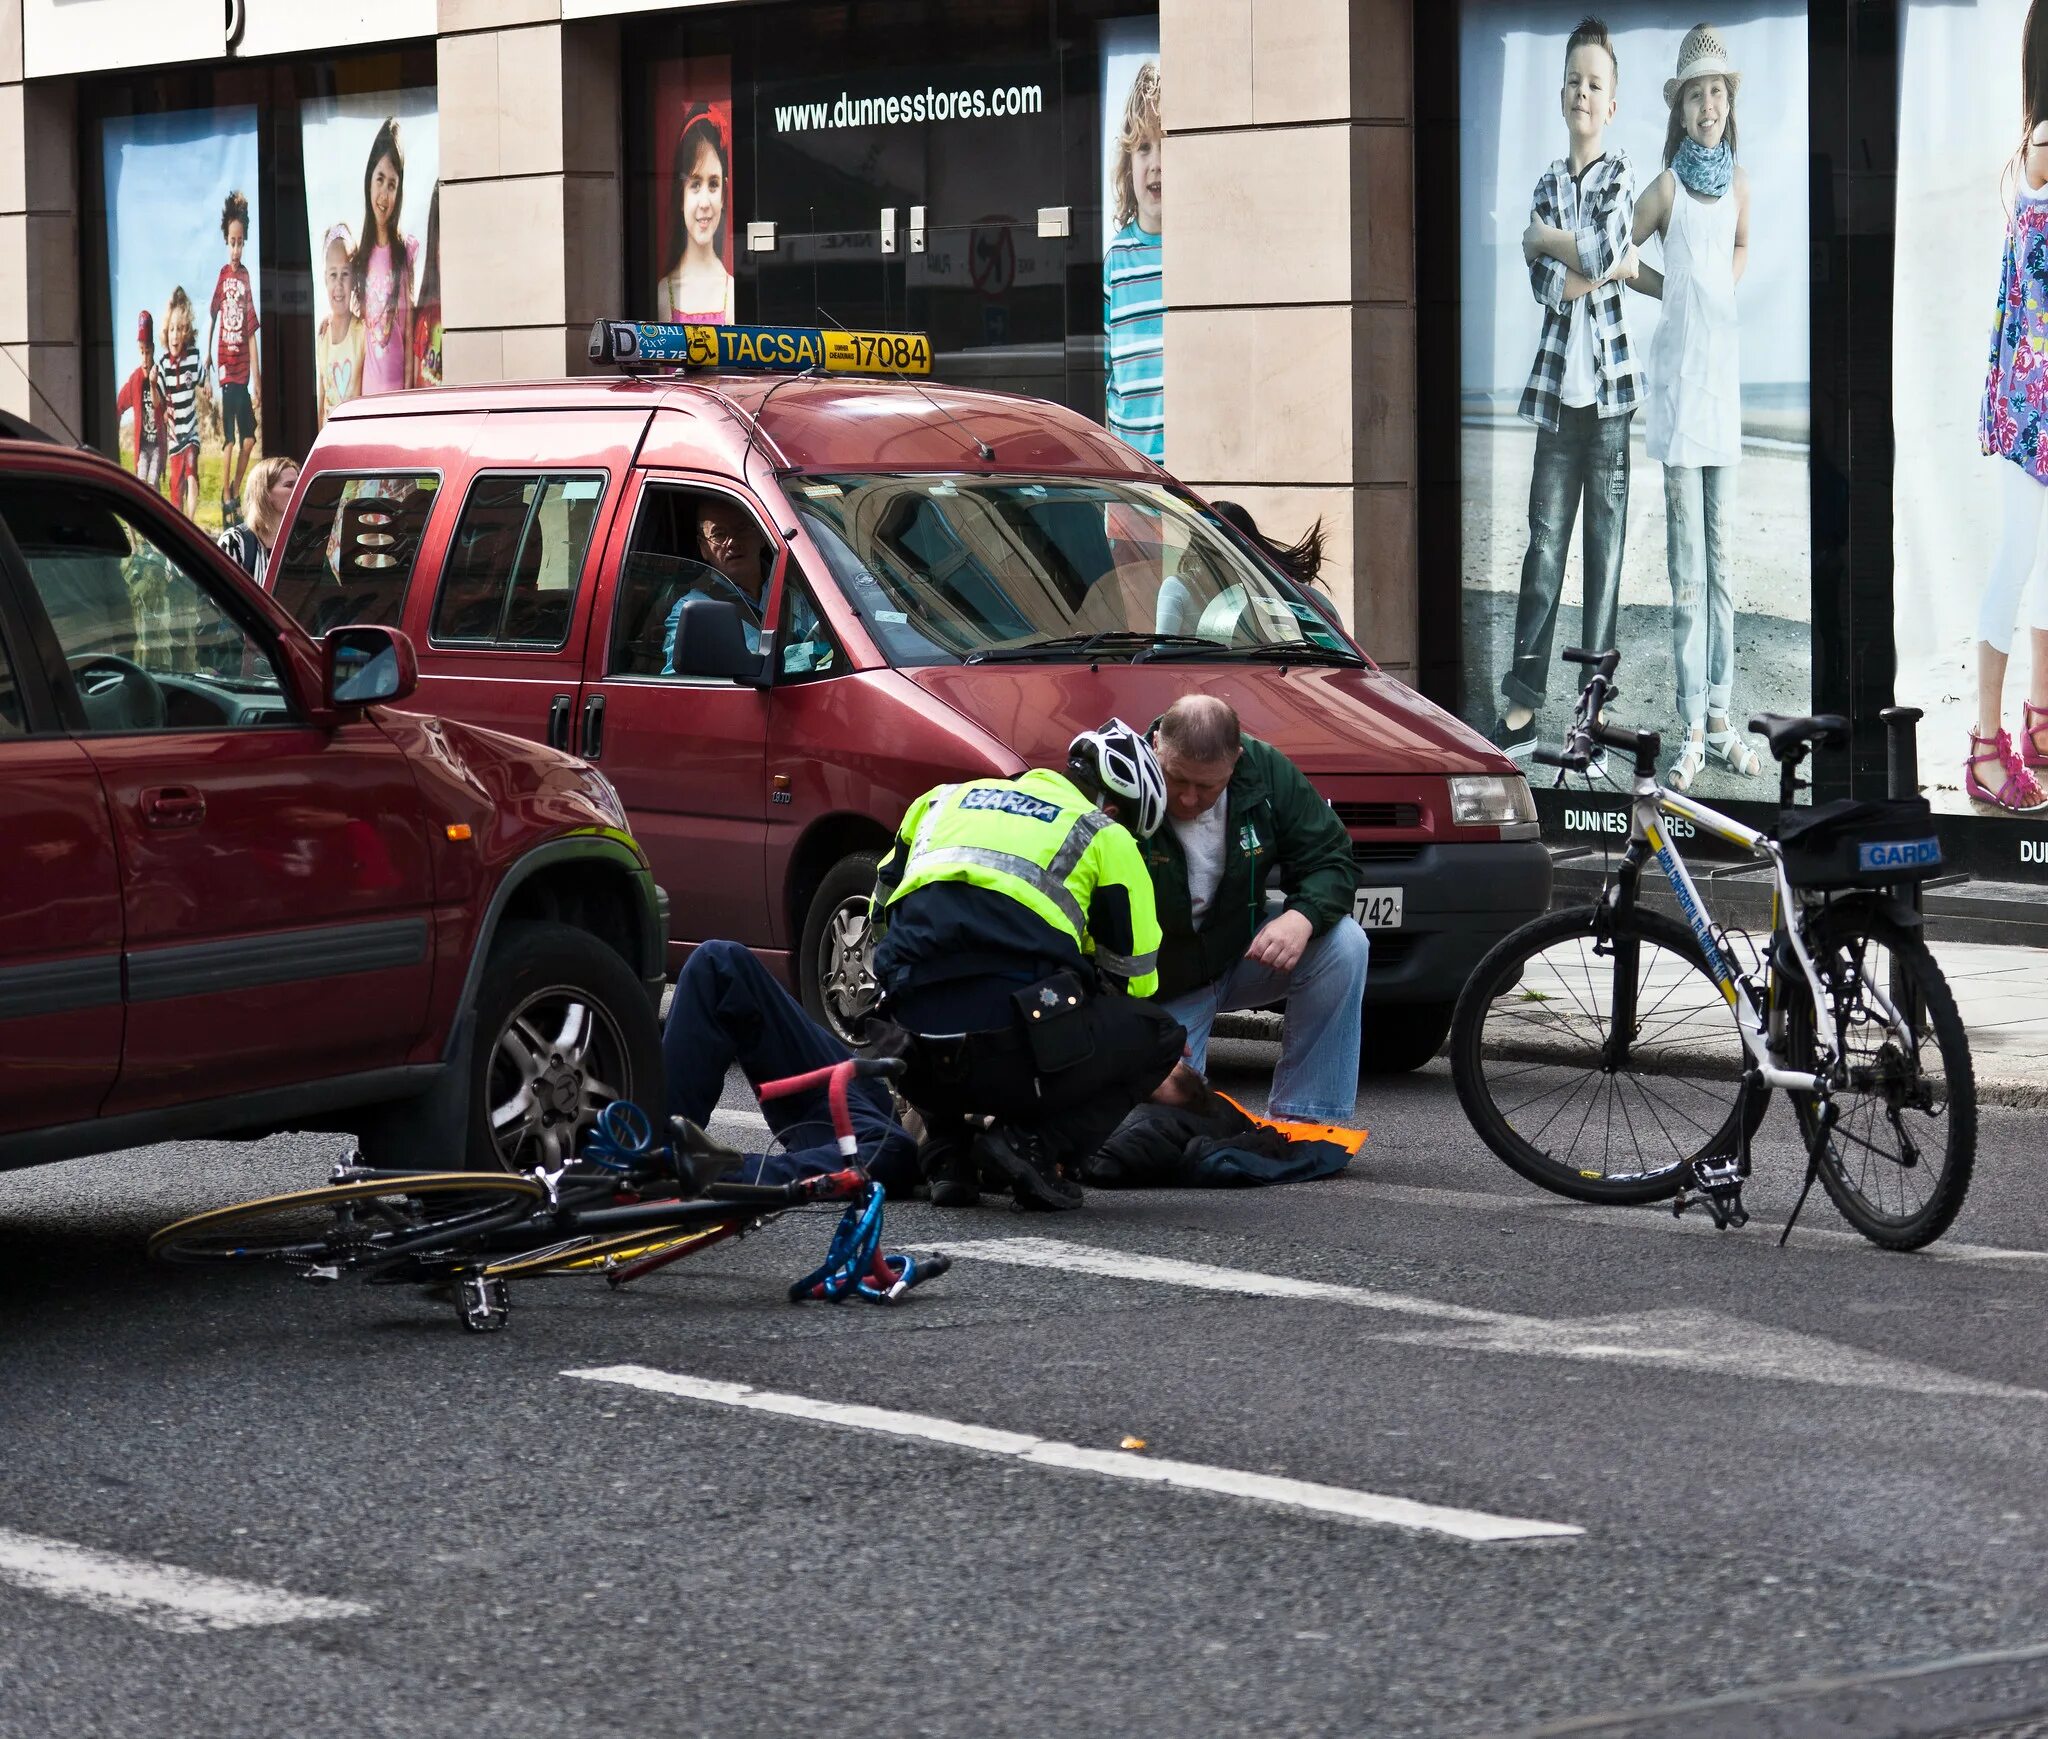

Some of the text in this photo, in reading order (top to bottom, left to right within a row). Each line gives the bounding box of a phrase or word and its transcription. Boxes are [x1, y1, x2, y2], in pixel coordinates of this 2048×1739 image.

[775, 85, 1042, 132] www.dunnesstores.com
[638, 335, 667, 348] TAXIS
[648, 349, 665, 359] 72
[670, 350, 688, 360] 72
[851, 335, 927, 368] 17084
[964, 788, 1058, 821] GARDA
[1565, 809, 1628, 834] DUNNES
[1656, 846, 1675, 876] GARDA
[1668, 869, 1699, 924] CONFIDENTIAL
[1356, 897, 1394, 926] 742
